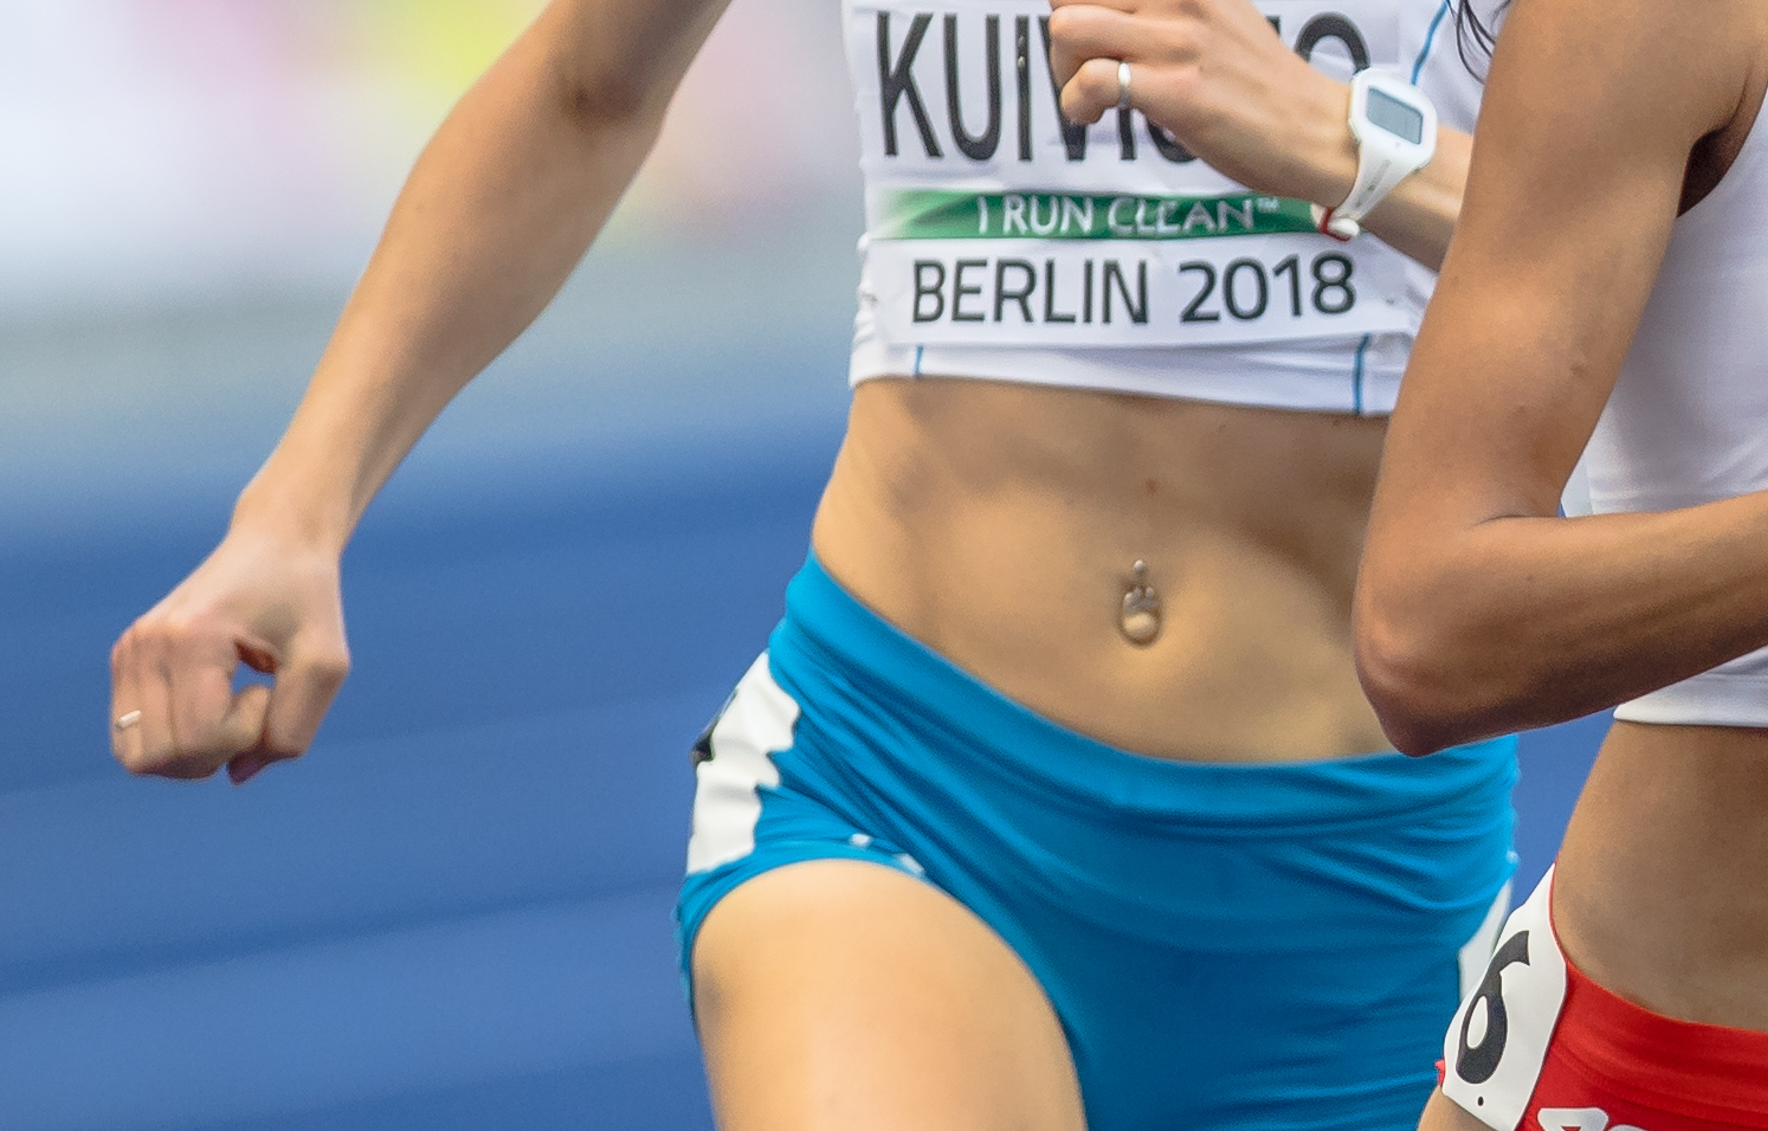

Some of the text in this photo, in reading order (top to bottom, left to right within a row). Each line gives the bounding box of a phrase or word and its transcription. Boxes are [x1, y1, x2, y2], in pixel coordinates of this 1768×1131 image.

[976, 196, 988, 234] I
[1003, 196, 1094, 235] RUN
[912, 249, 1358, 325] BERLIN 2018
